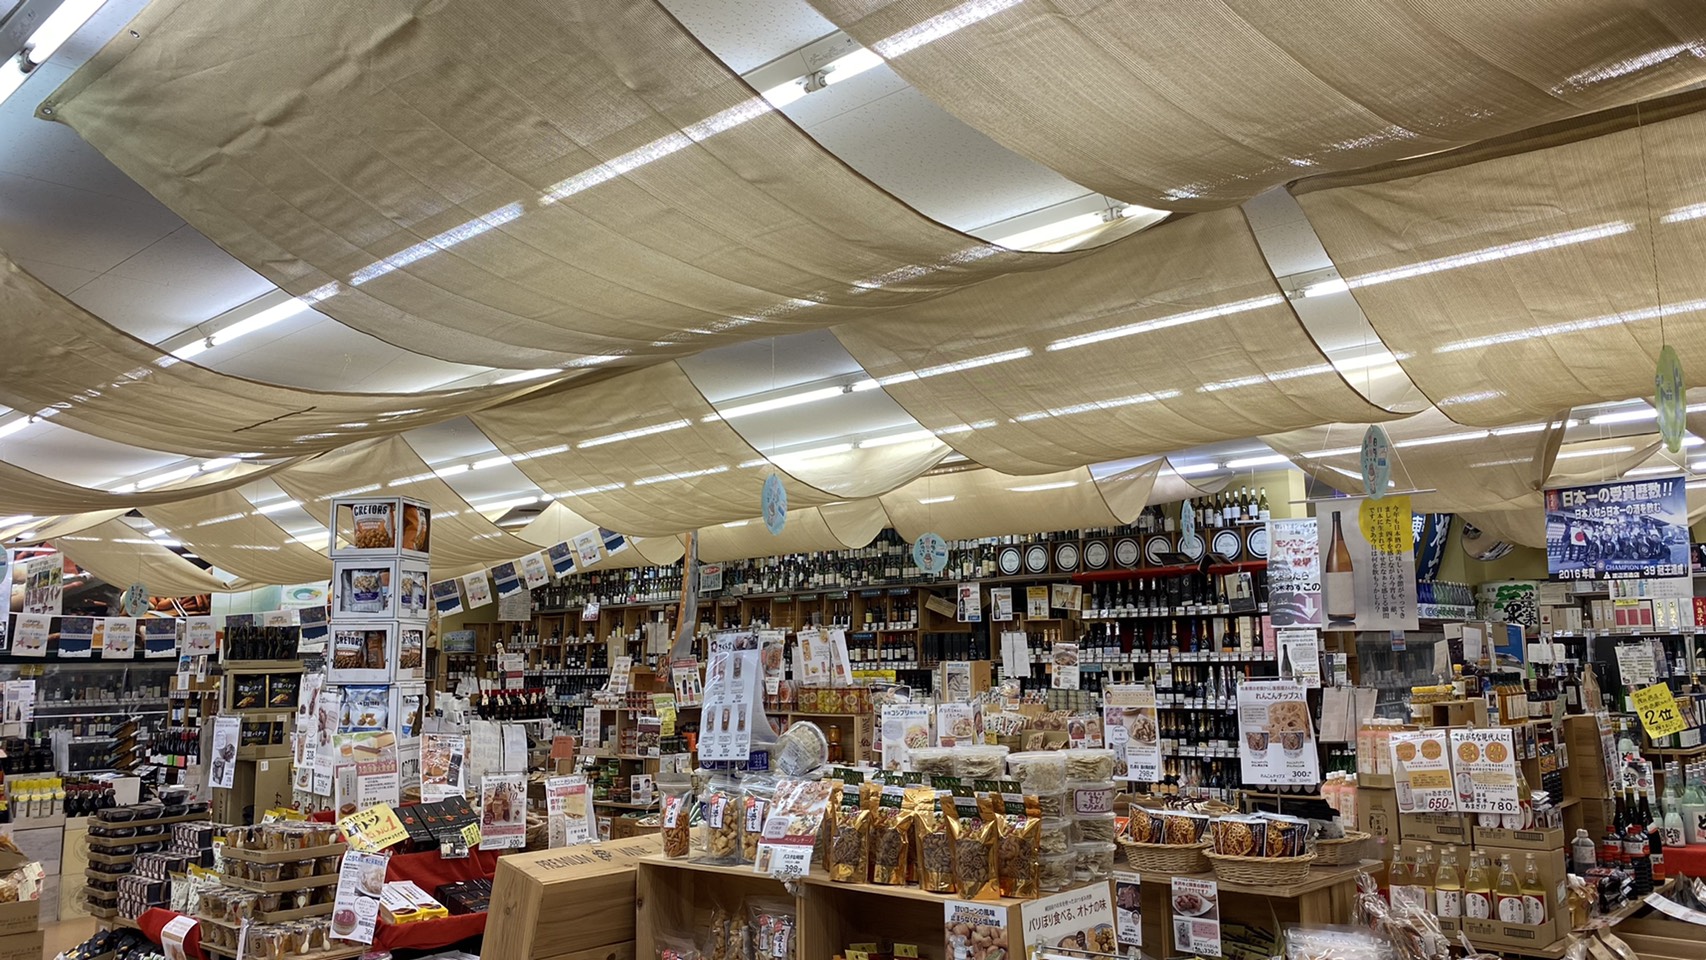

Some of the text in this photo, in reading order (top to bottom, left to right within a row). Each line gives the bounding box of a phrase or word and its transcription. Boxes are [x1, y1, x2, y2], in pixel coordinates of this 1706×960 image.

[354, 504, 388, 517] CRETORS
[335, 634, 363, 647] CRETORS
[535, 844, 652, 871] PREMIUM WINE
